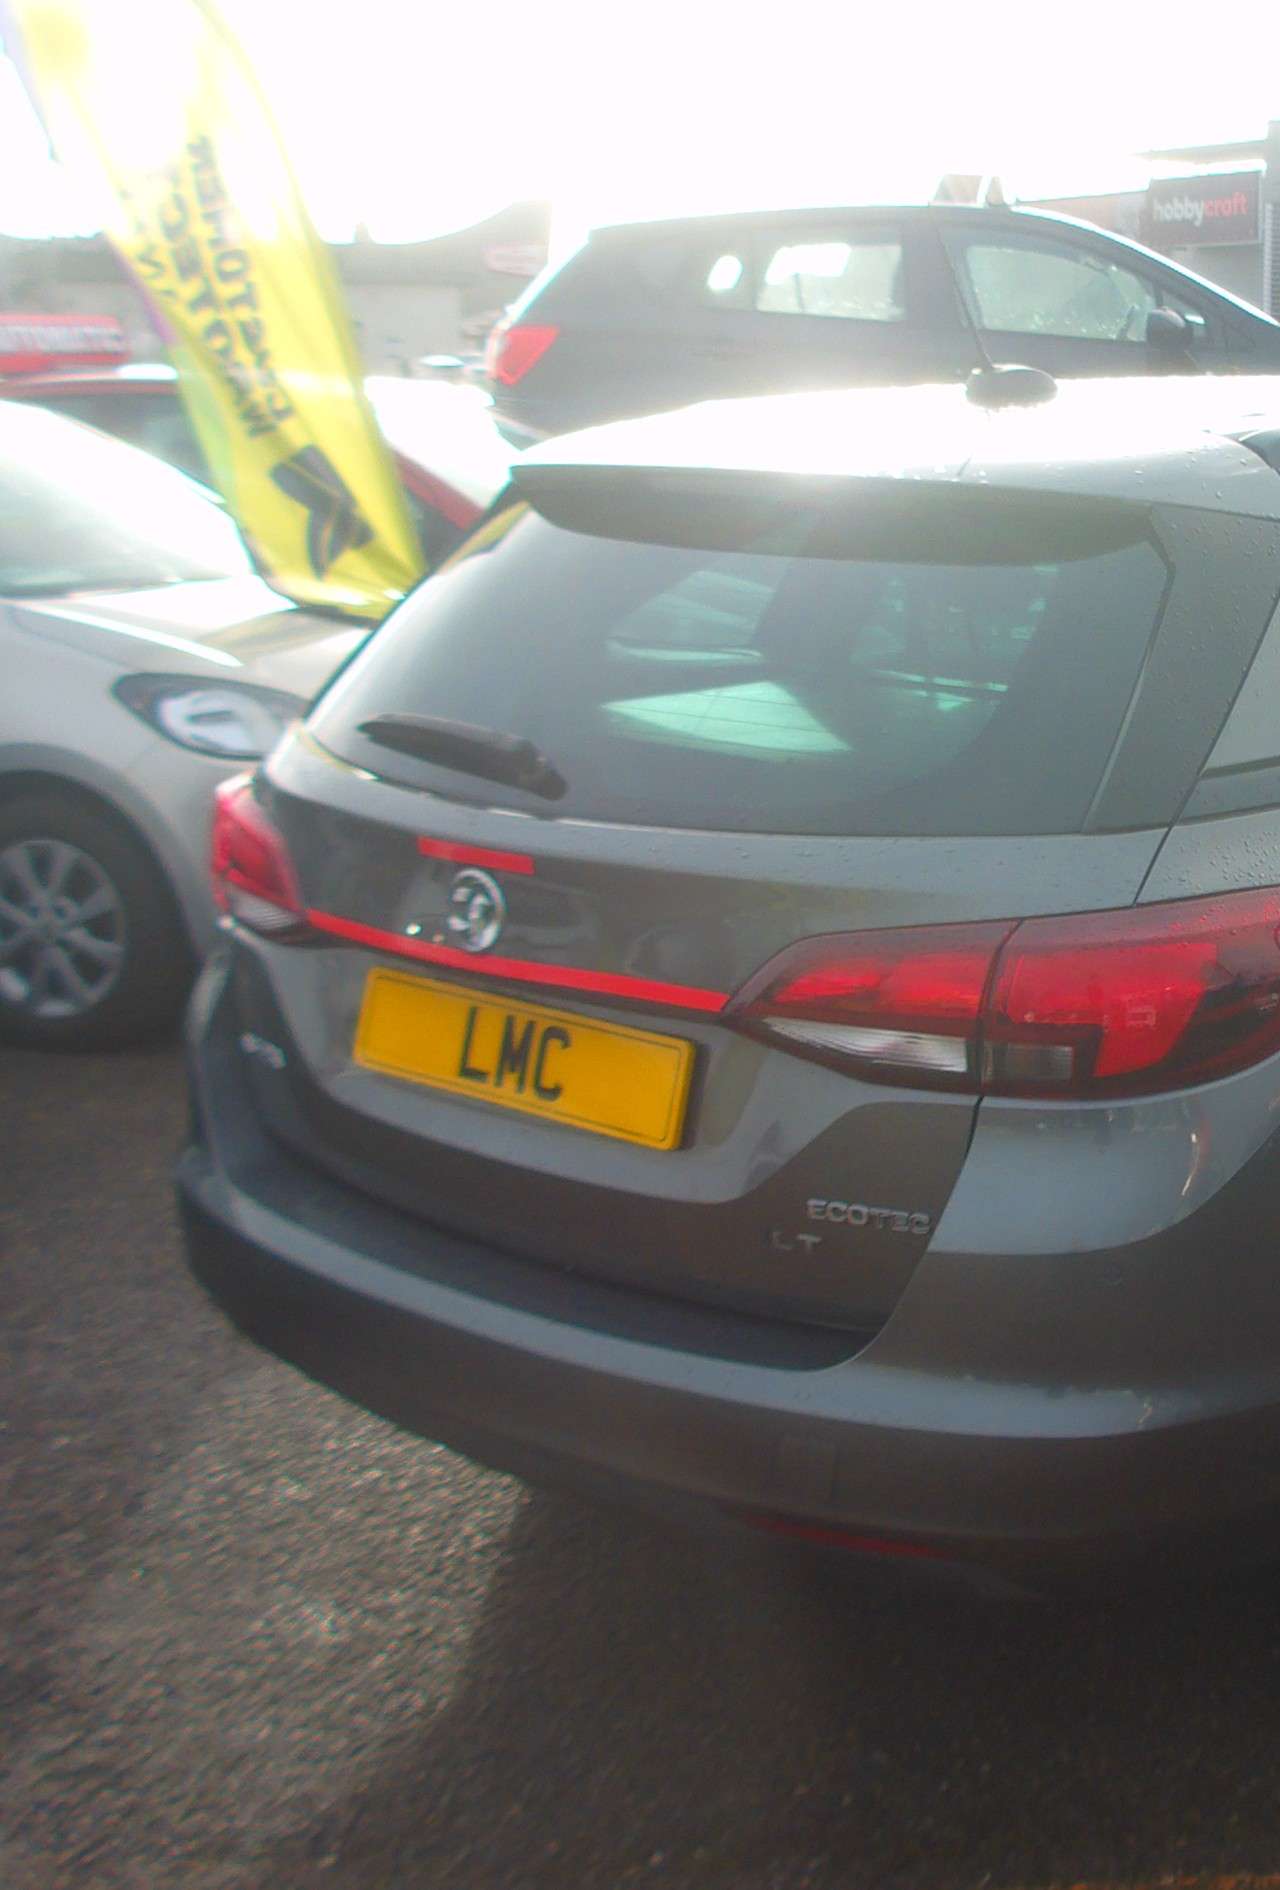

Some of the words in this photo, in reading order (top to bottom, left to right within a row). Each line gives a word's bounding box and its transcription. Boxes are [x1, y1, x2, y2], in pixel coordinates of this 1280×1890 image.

[459, 1006, 571, 1101] LMC
[807, 1199, 931, 1234] ECOTEC
[772, 1230, 822, 1254] LT
